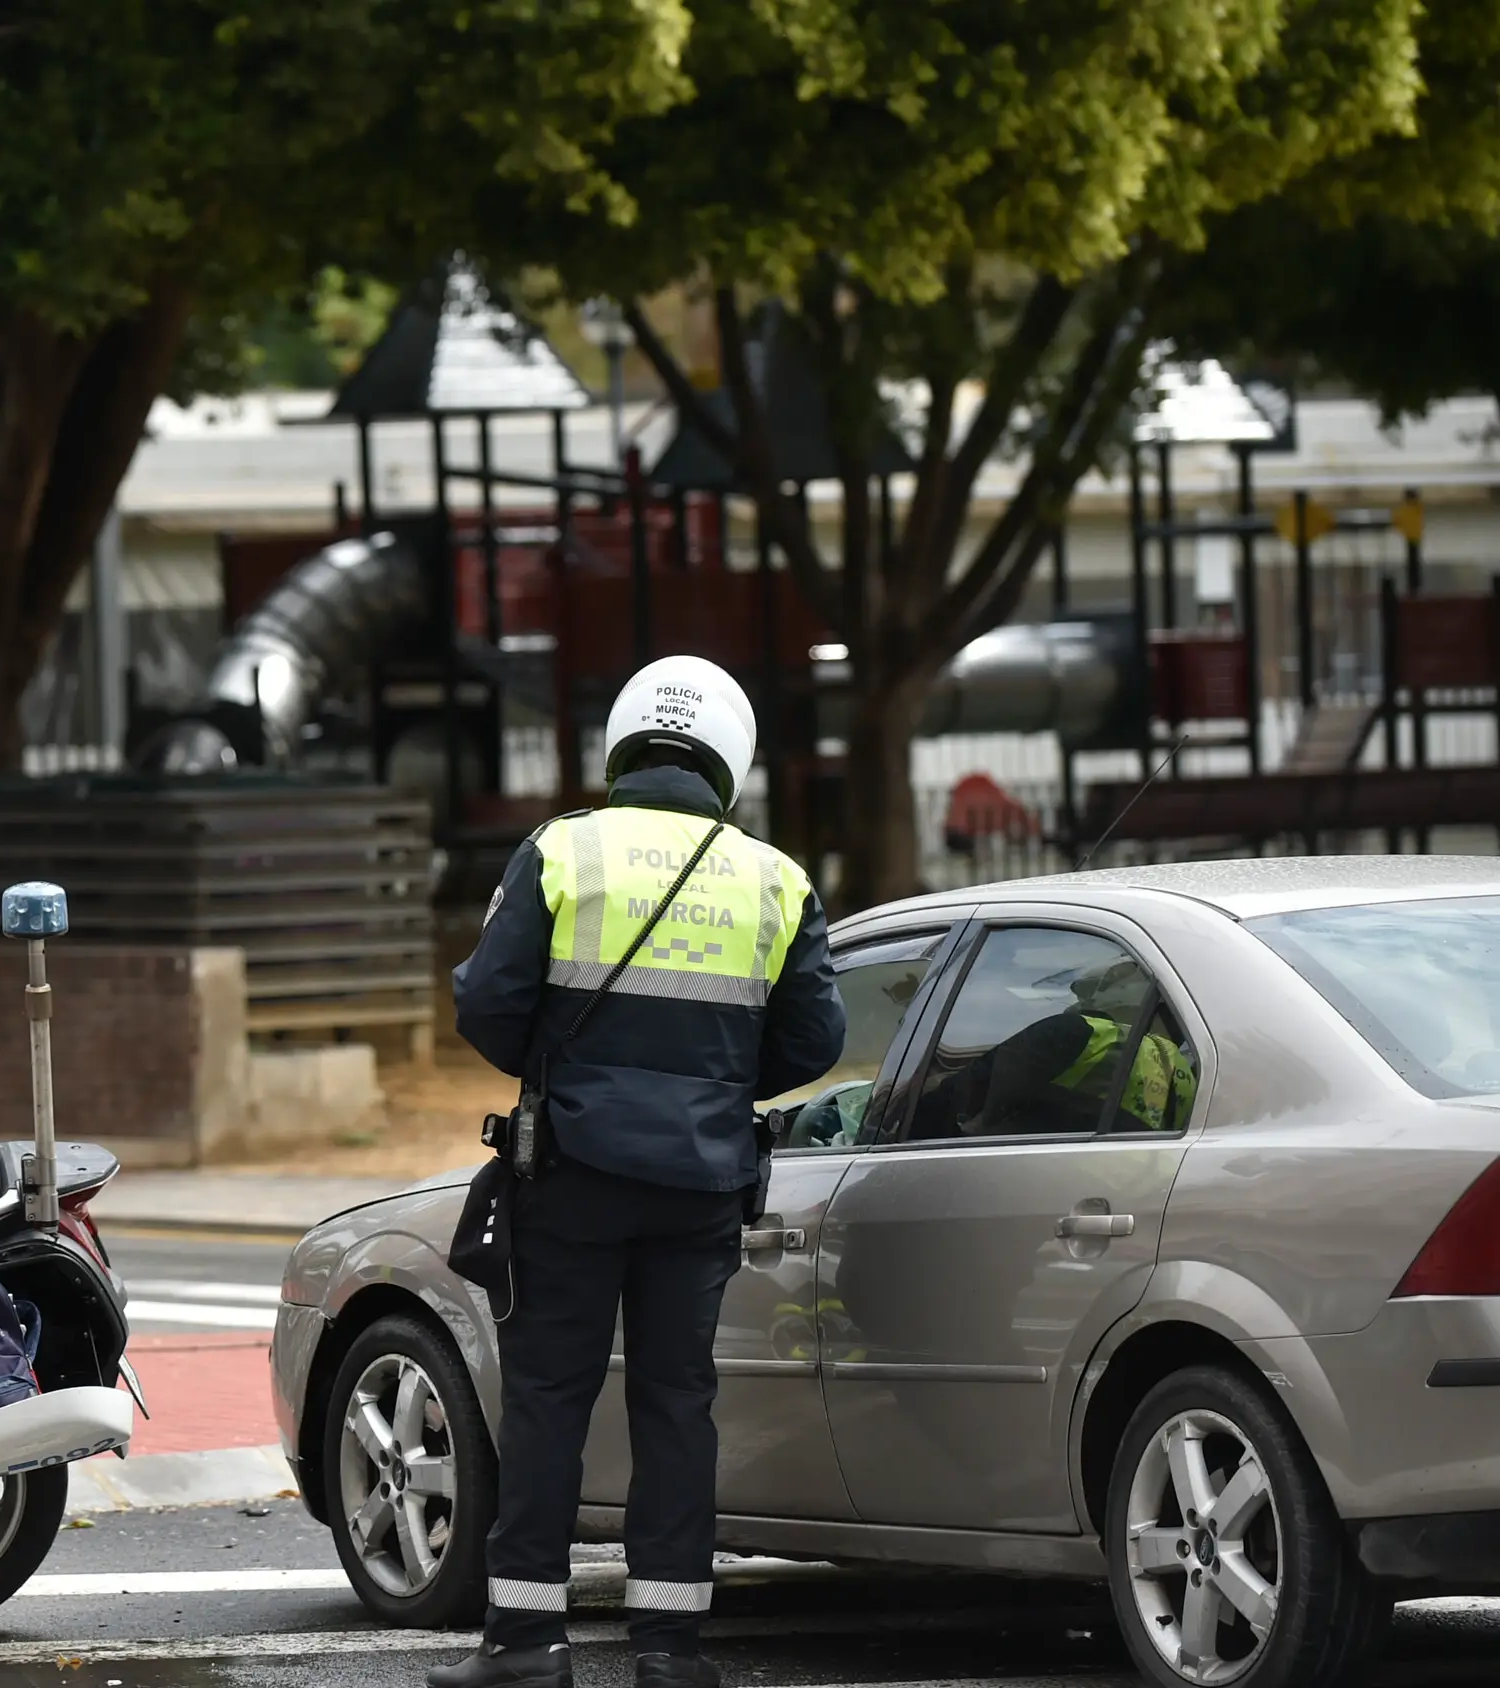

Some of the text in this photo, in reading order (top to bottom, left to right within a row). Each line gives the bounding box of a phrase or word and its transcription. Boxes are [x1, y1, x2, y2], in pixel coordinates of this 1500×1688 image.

[656, 686, 704, 704] POLICIA
[665, 697, 690, 706] LOCAL
[656, 704, 696, 720] MURCIA
